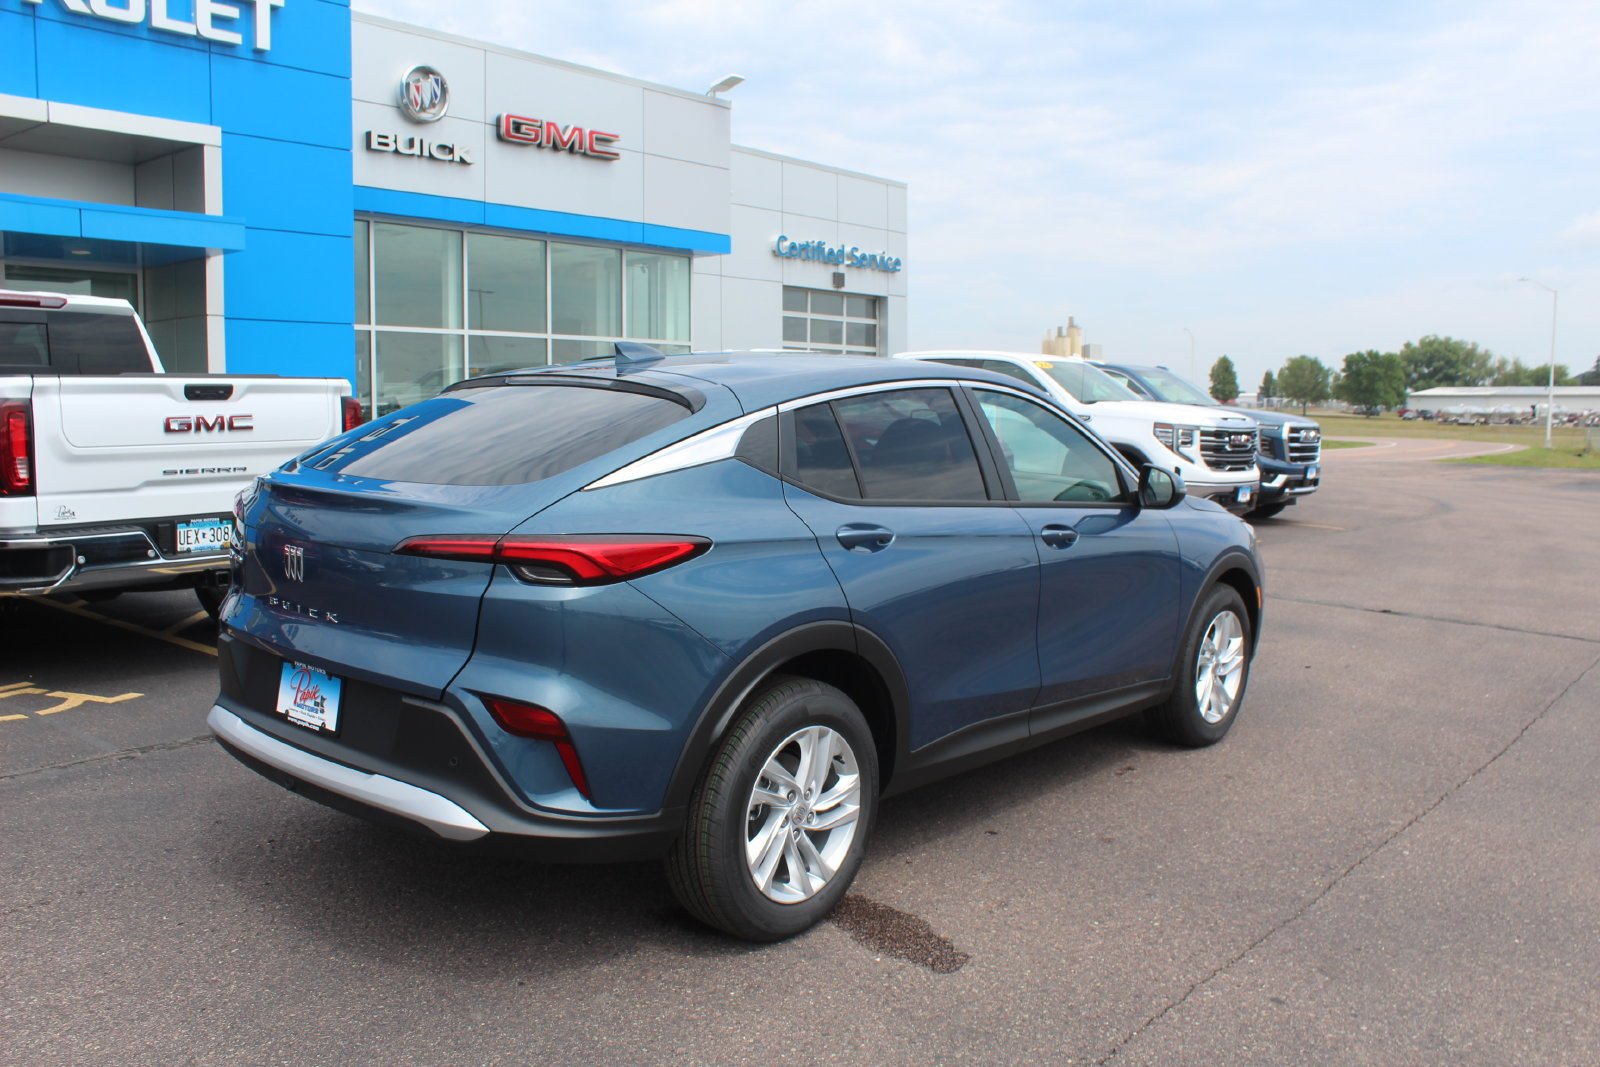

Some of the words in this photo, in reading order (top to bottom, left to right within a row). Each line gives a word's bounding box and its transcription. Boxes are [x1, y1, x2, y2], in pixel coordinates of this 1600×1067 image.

[367, 130, 474, 165] BUICK
[497, 113, 621, 161] GMC
[775, 234, 845, 265] Certified
[847, 246, 902, 273] Service
[164, 414, 254, 434] GMC
[162, 466, 248, 476] SIERRA
[179, 529, 200, 545] UEX
[209, 527, 230, 542] 308
[269, 596, 339, 624] BUICK
